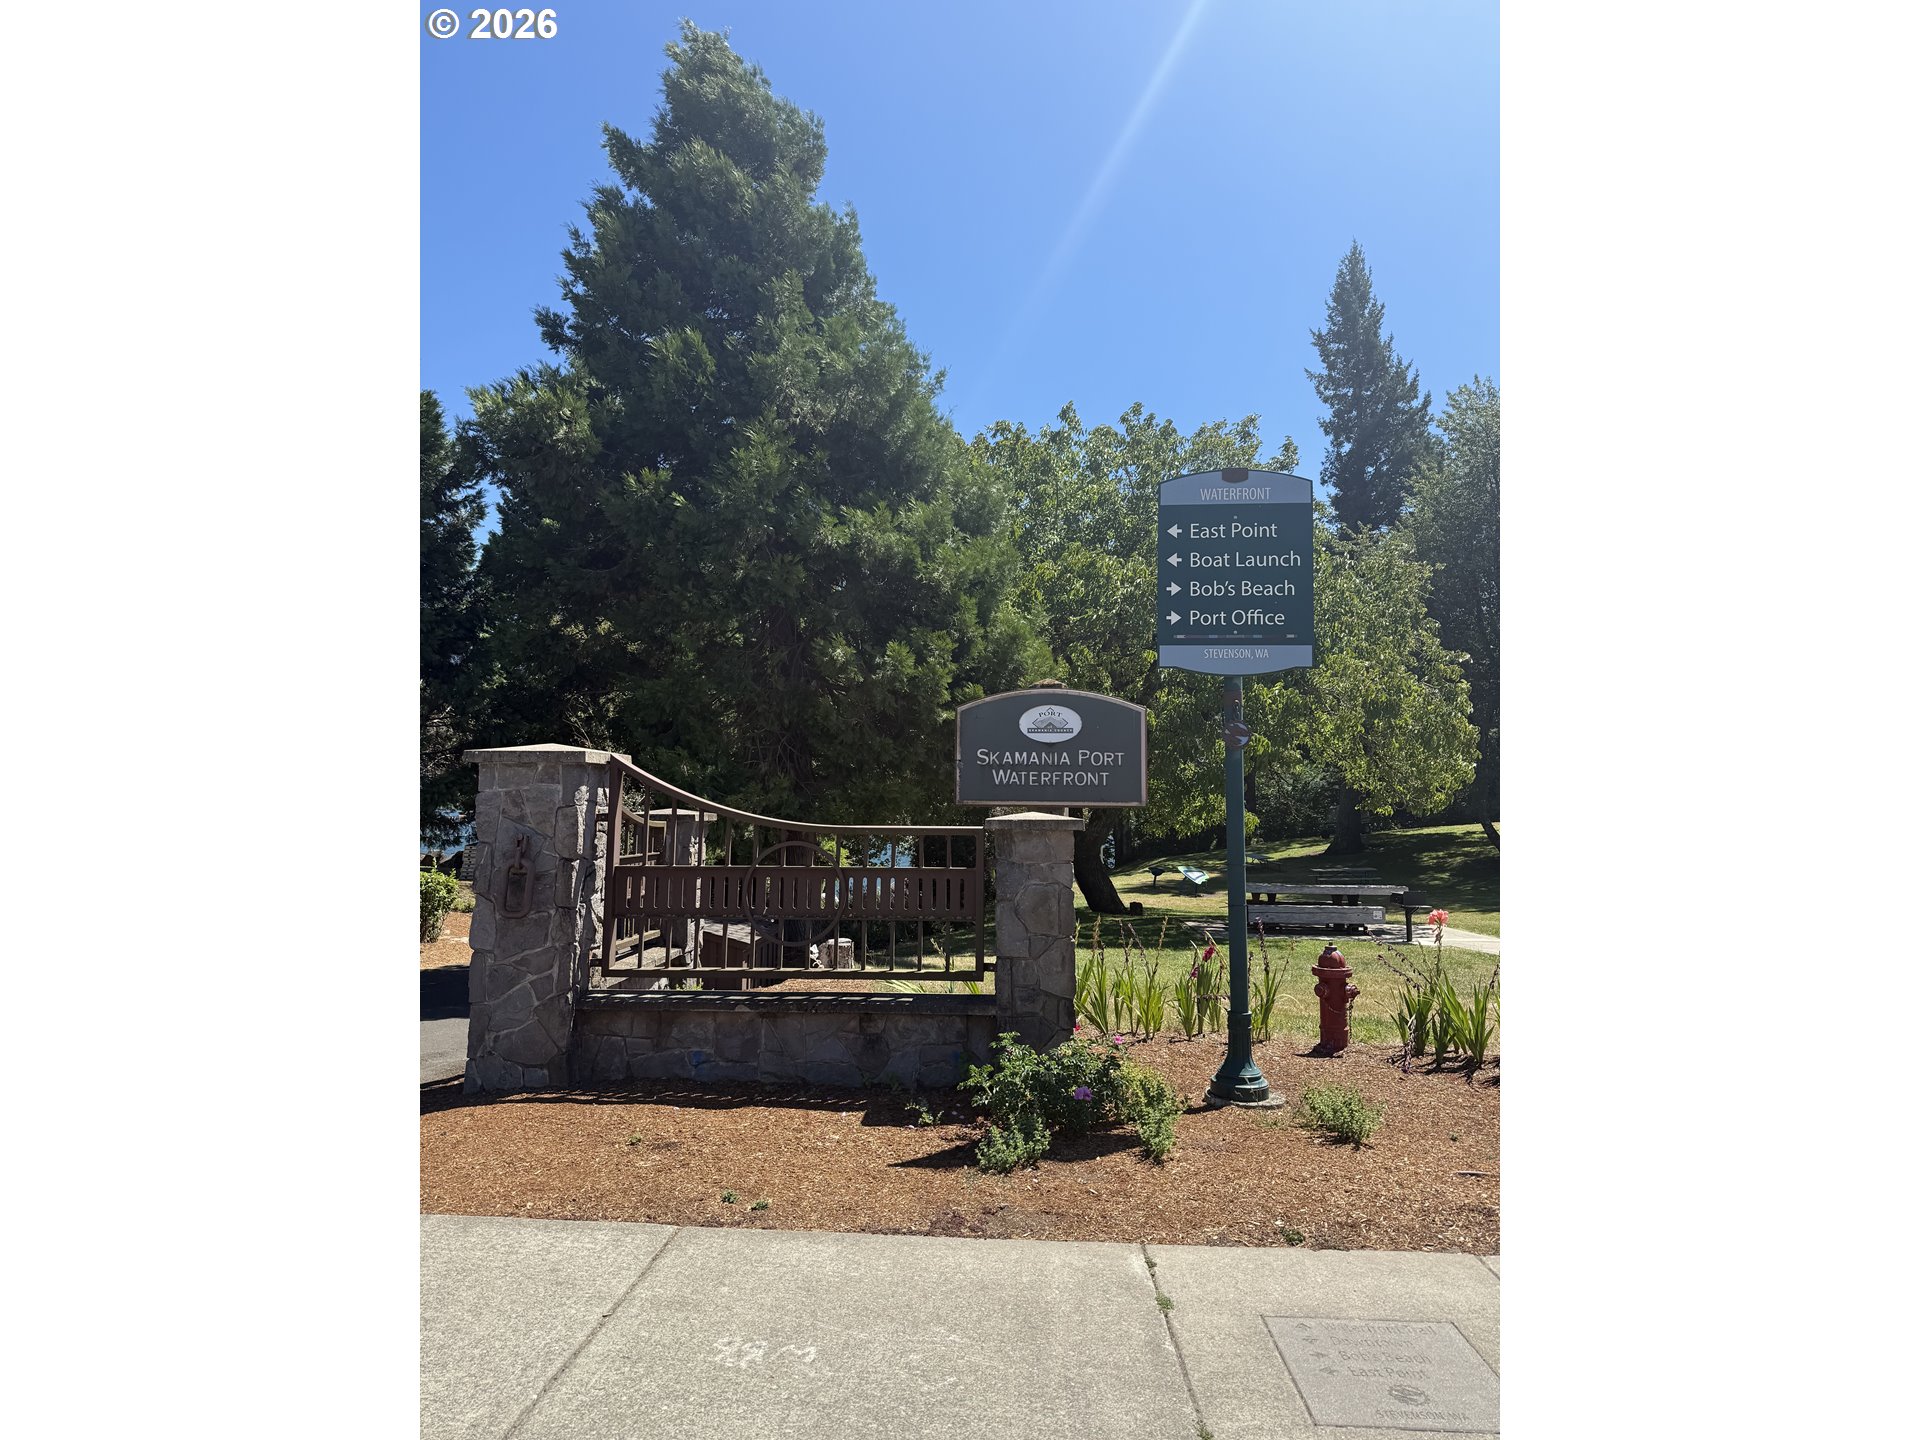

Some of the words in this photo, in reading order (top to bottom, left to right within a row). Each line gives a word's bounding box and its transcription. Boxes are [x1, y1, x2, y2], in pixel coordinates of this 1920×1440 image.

[1200, 487, 1271, 501] WATERFRONT
[1190, 523, 1226, 539] East
[1231, 522, 1278, 538] Point
[1190, 552, 1230, 568] Boat
[1235, 550, 1301, 567] Launch
[1190, 580, 1236, 596] Bob's
[1241, 580, 1295, 596] Beach
[1189, 610, 1227, 626] Port
[1231, 609, 1285, 626] Office
[1204, 648, 1254, 660] STEVENSON,
[1255, 648, 1269, 659] WA
[976, 748, 1071, 766] SKAMANIA
[1078, 749, 1125, 767] PORT
[992, 769, 1110, 787] WATERFRONT
[1347, 1366, 1383, 1378] East
